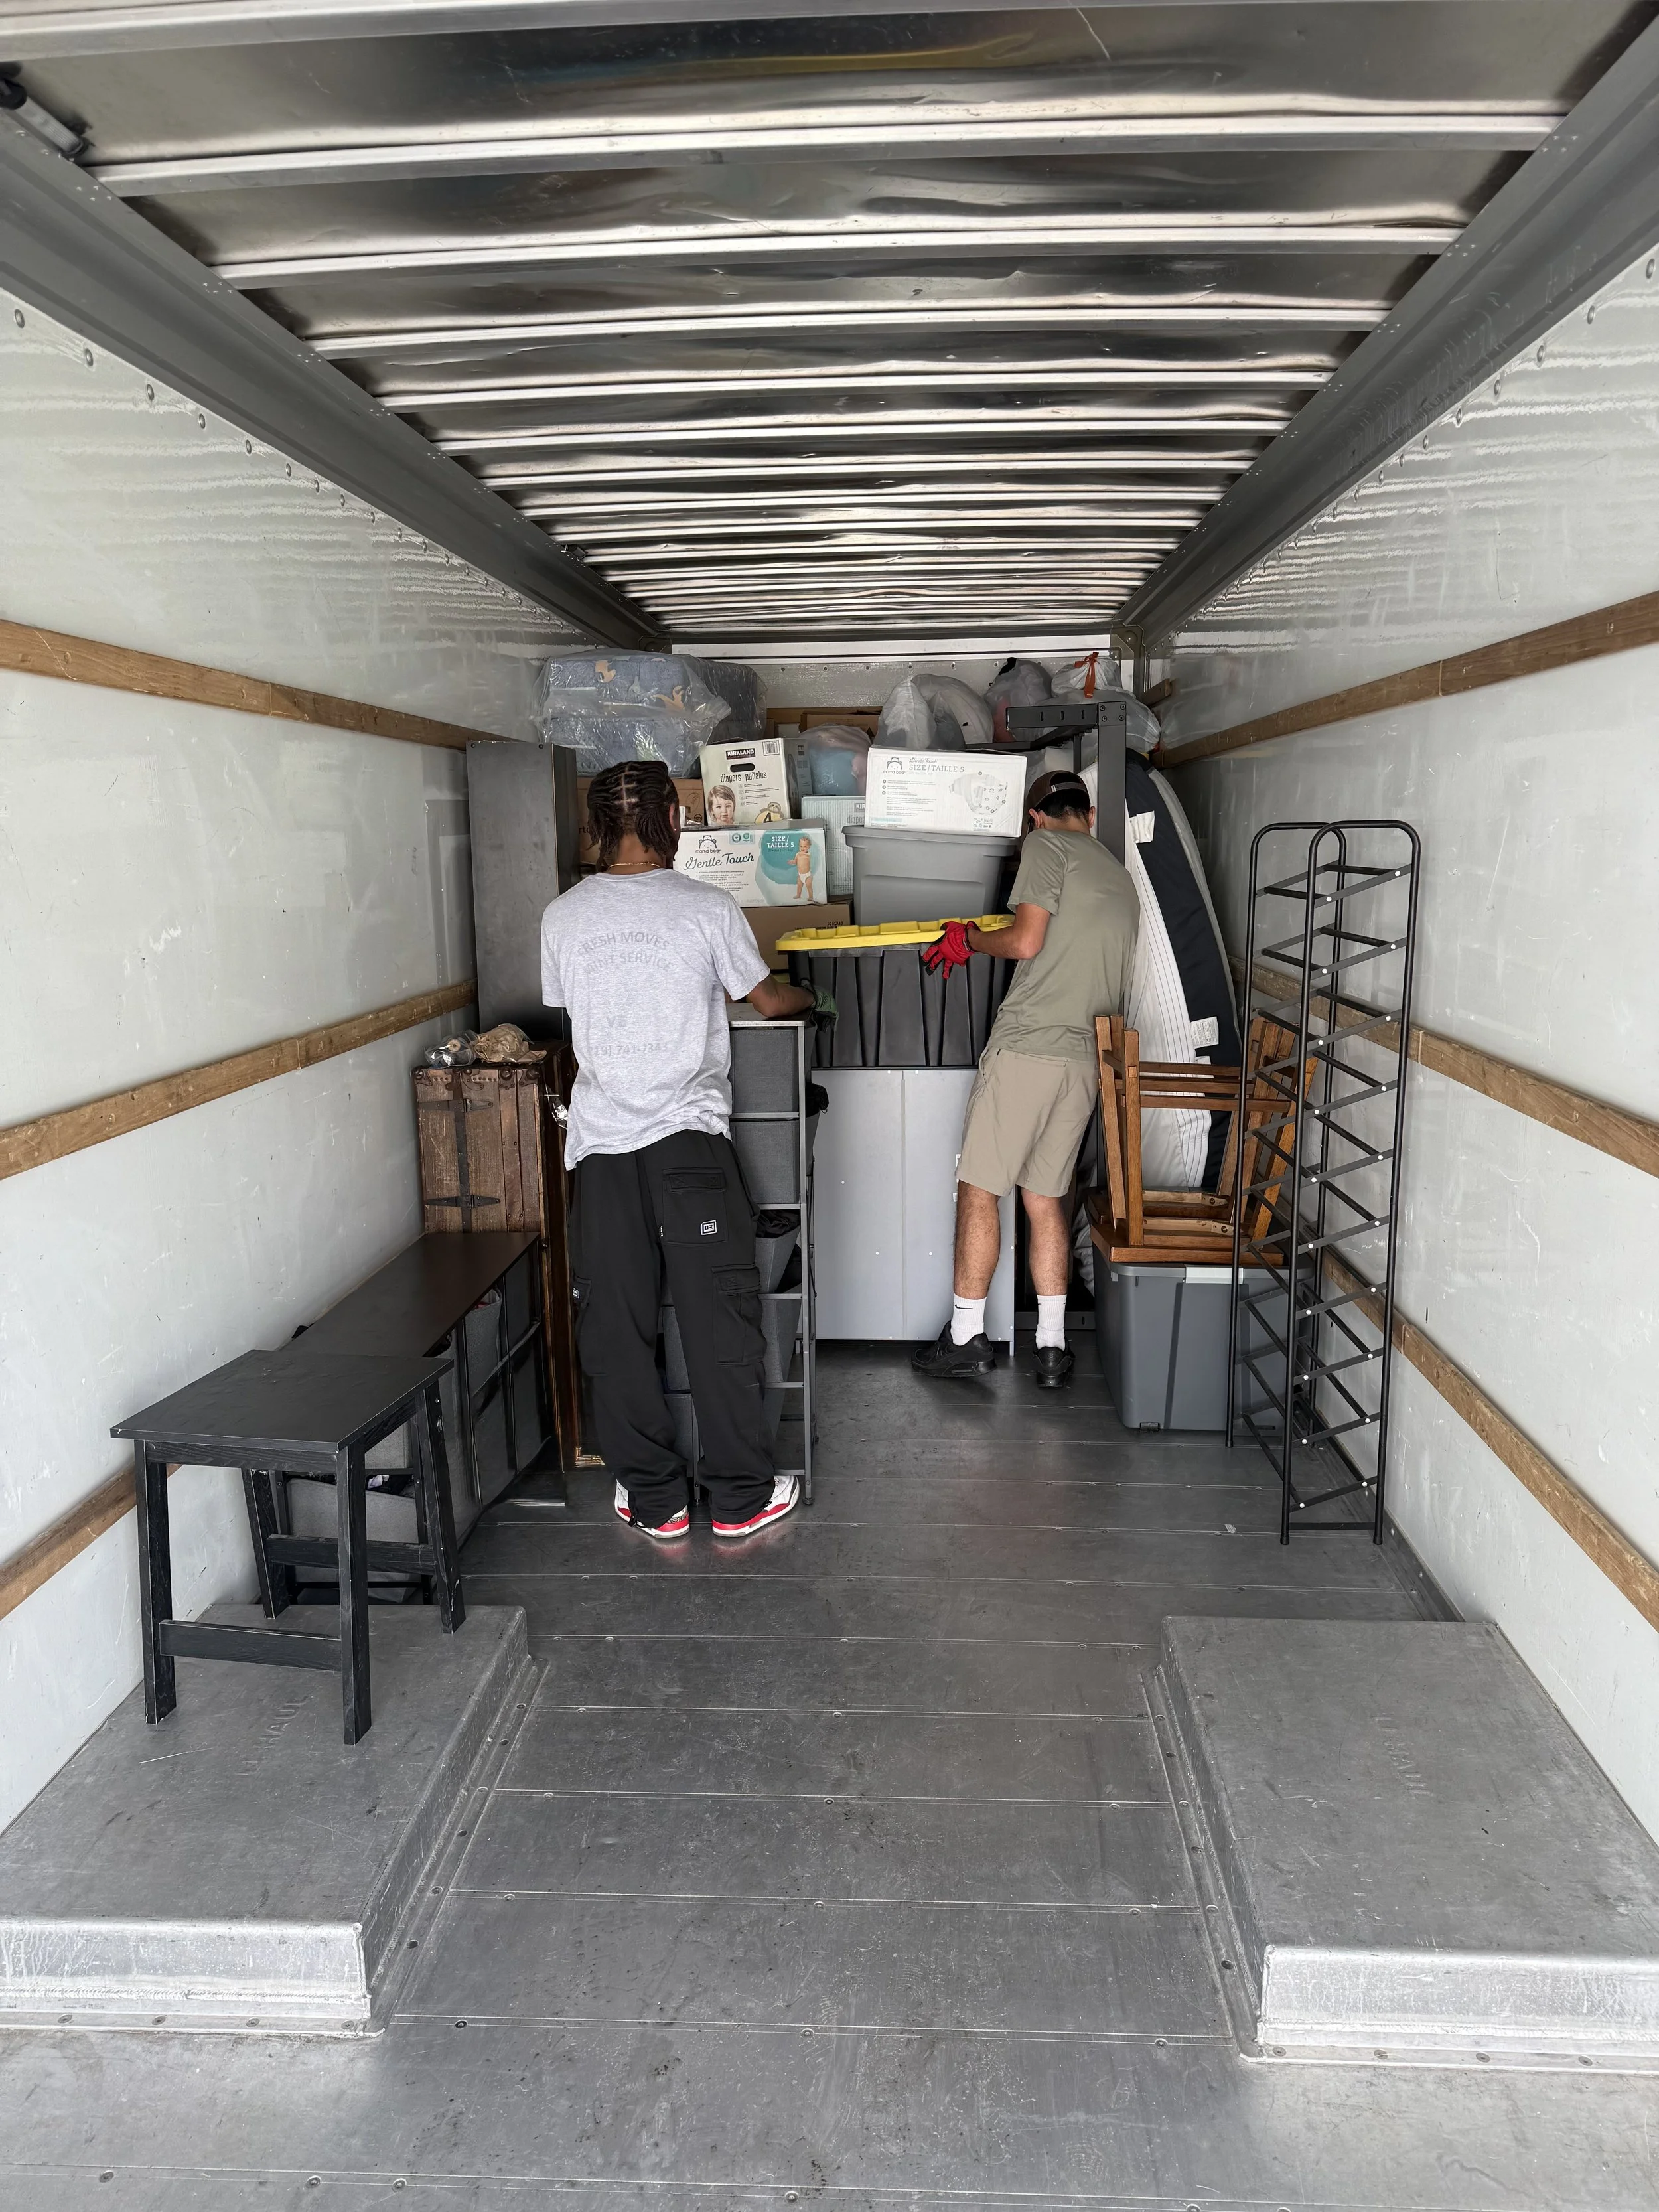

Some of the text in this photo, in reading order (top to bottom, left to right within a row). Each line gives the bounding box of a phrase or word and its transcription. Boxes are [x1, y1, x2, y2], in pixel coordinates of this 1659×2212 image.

[720, 771, 767, 783] diapers pañales
[763, 812, 772, 823] 4
[683, 852, 754, 871] Gentle Touch
[620, 932, 670, 950] MOVES
[234, 1696, 309, 1777] UHAUL
[1371, 1715, 1433, 1795] UHAUL
